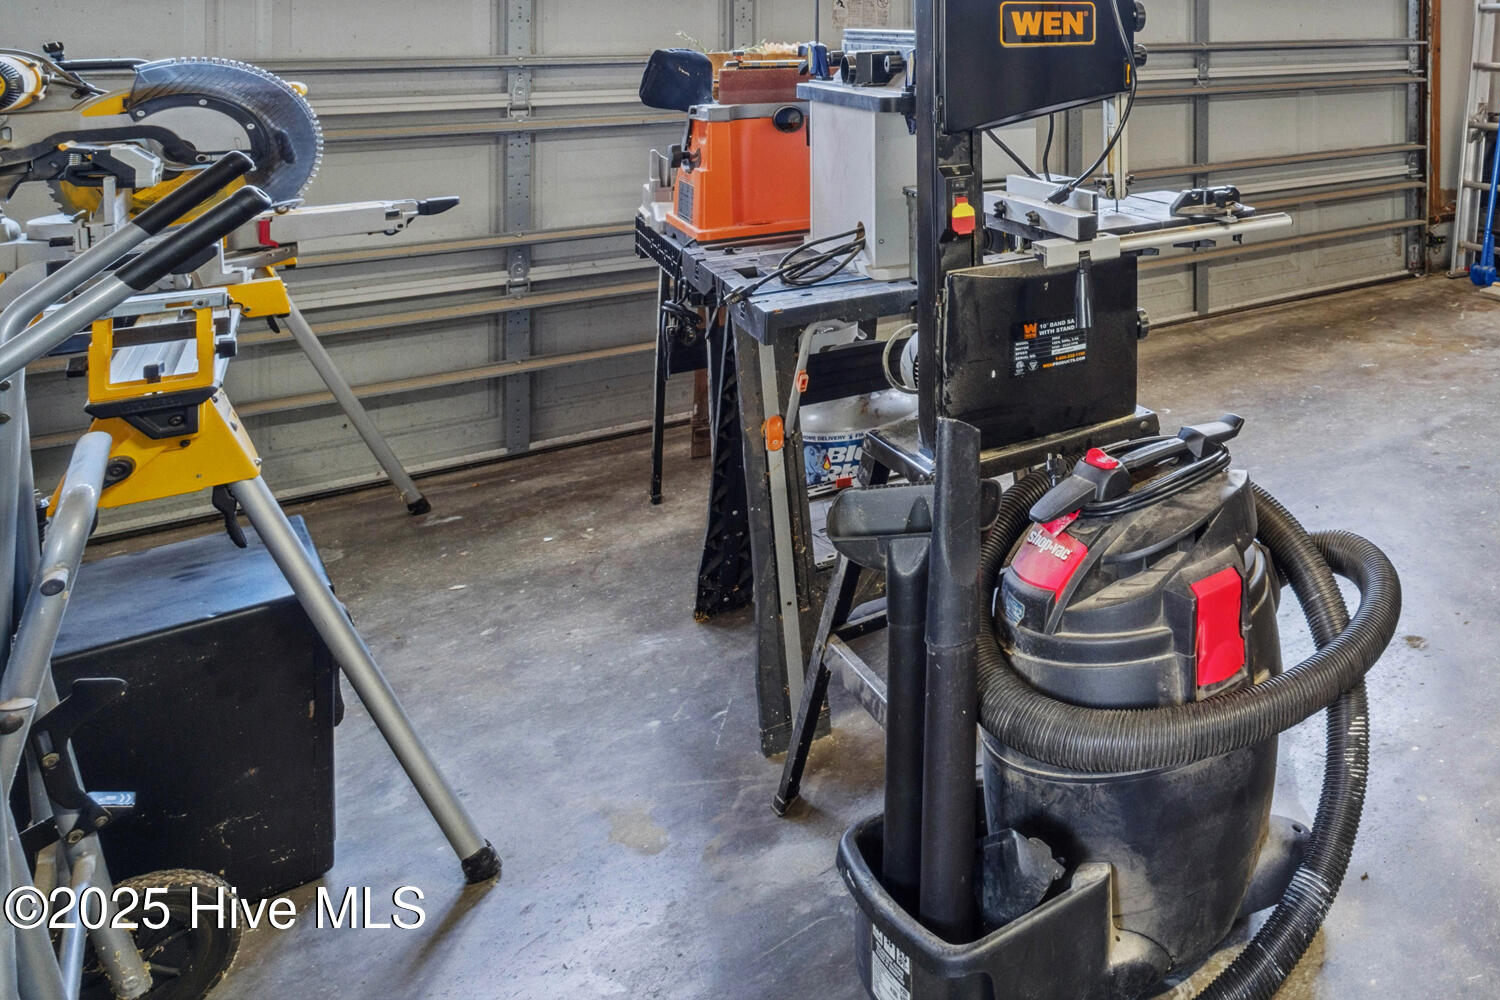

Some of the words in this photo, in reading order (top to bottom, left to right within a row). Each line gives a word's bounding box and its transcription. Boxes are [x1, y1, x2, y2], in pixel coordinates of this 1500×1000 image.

[1011, 11, 1085, 36] WEN
[1050, 319, 1066, 328] BAND
[1039, 328, 1055, 336] WITH
[1056, 325, 1076, 333] STAND
